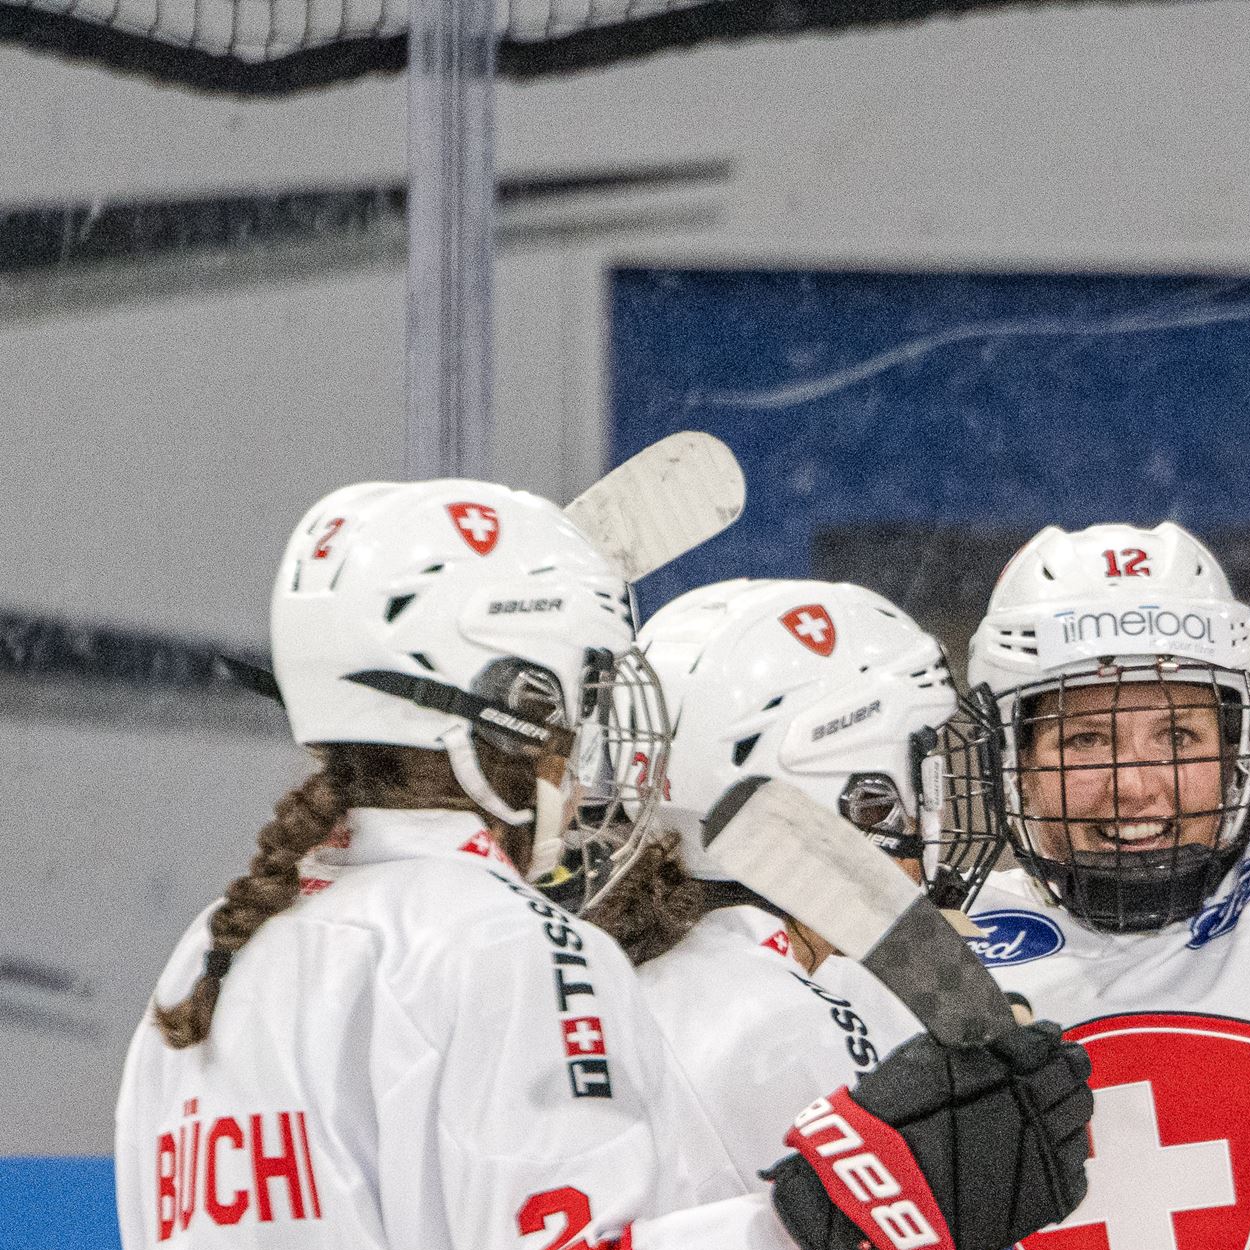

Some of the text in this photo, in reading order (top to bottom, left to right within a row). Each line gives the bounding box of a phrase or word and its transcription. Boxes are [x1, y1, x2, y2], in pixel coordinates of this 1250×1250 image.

[1102, 548, 1150, 577] 12
[811, 699, 882, 742] BAUER
[155, 1098, 322, 1242] BÜCHI
